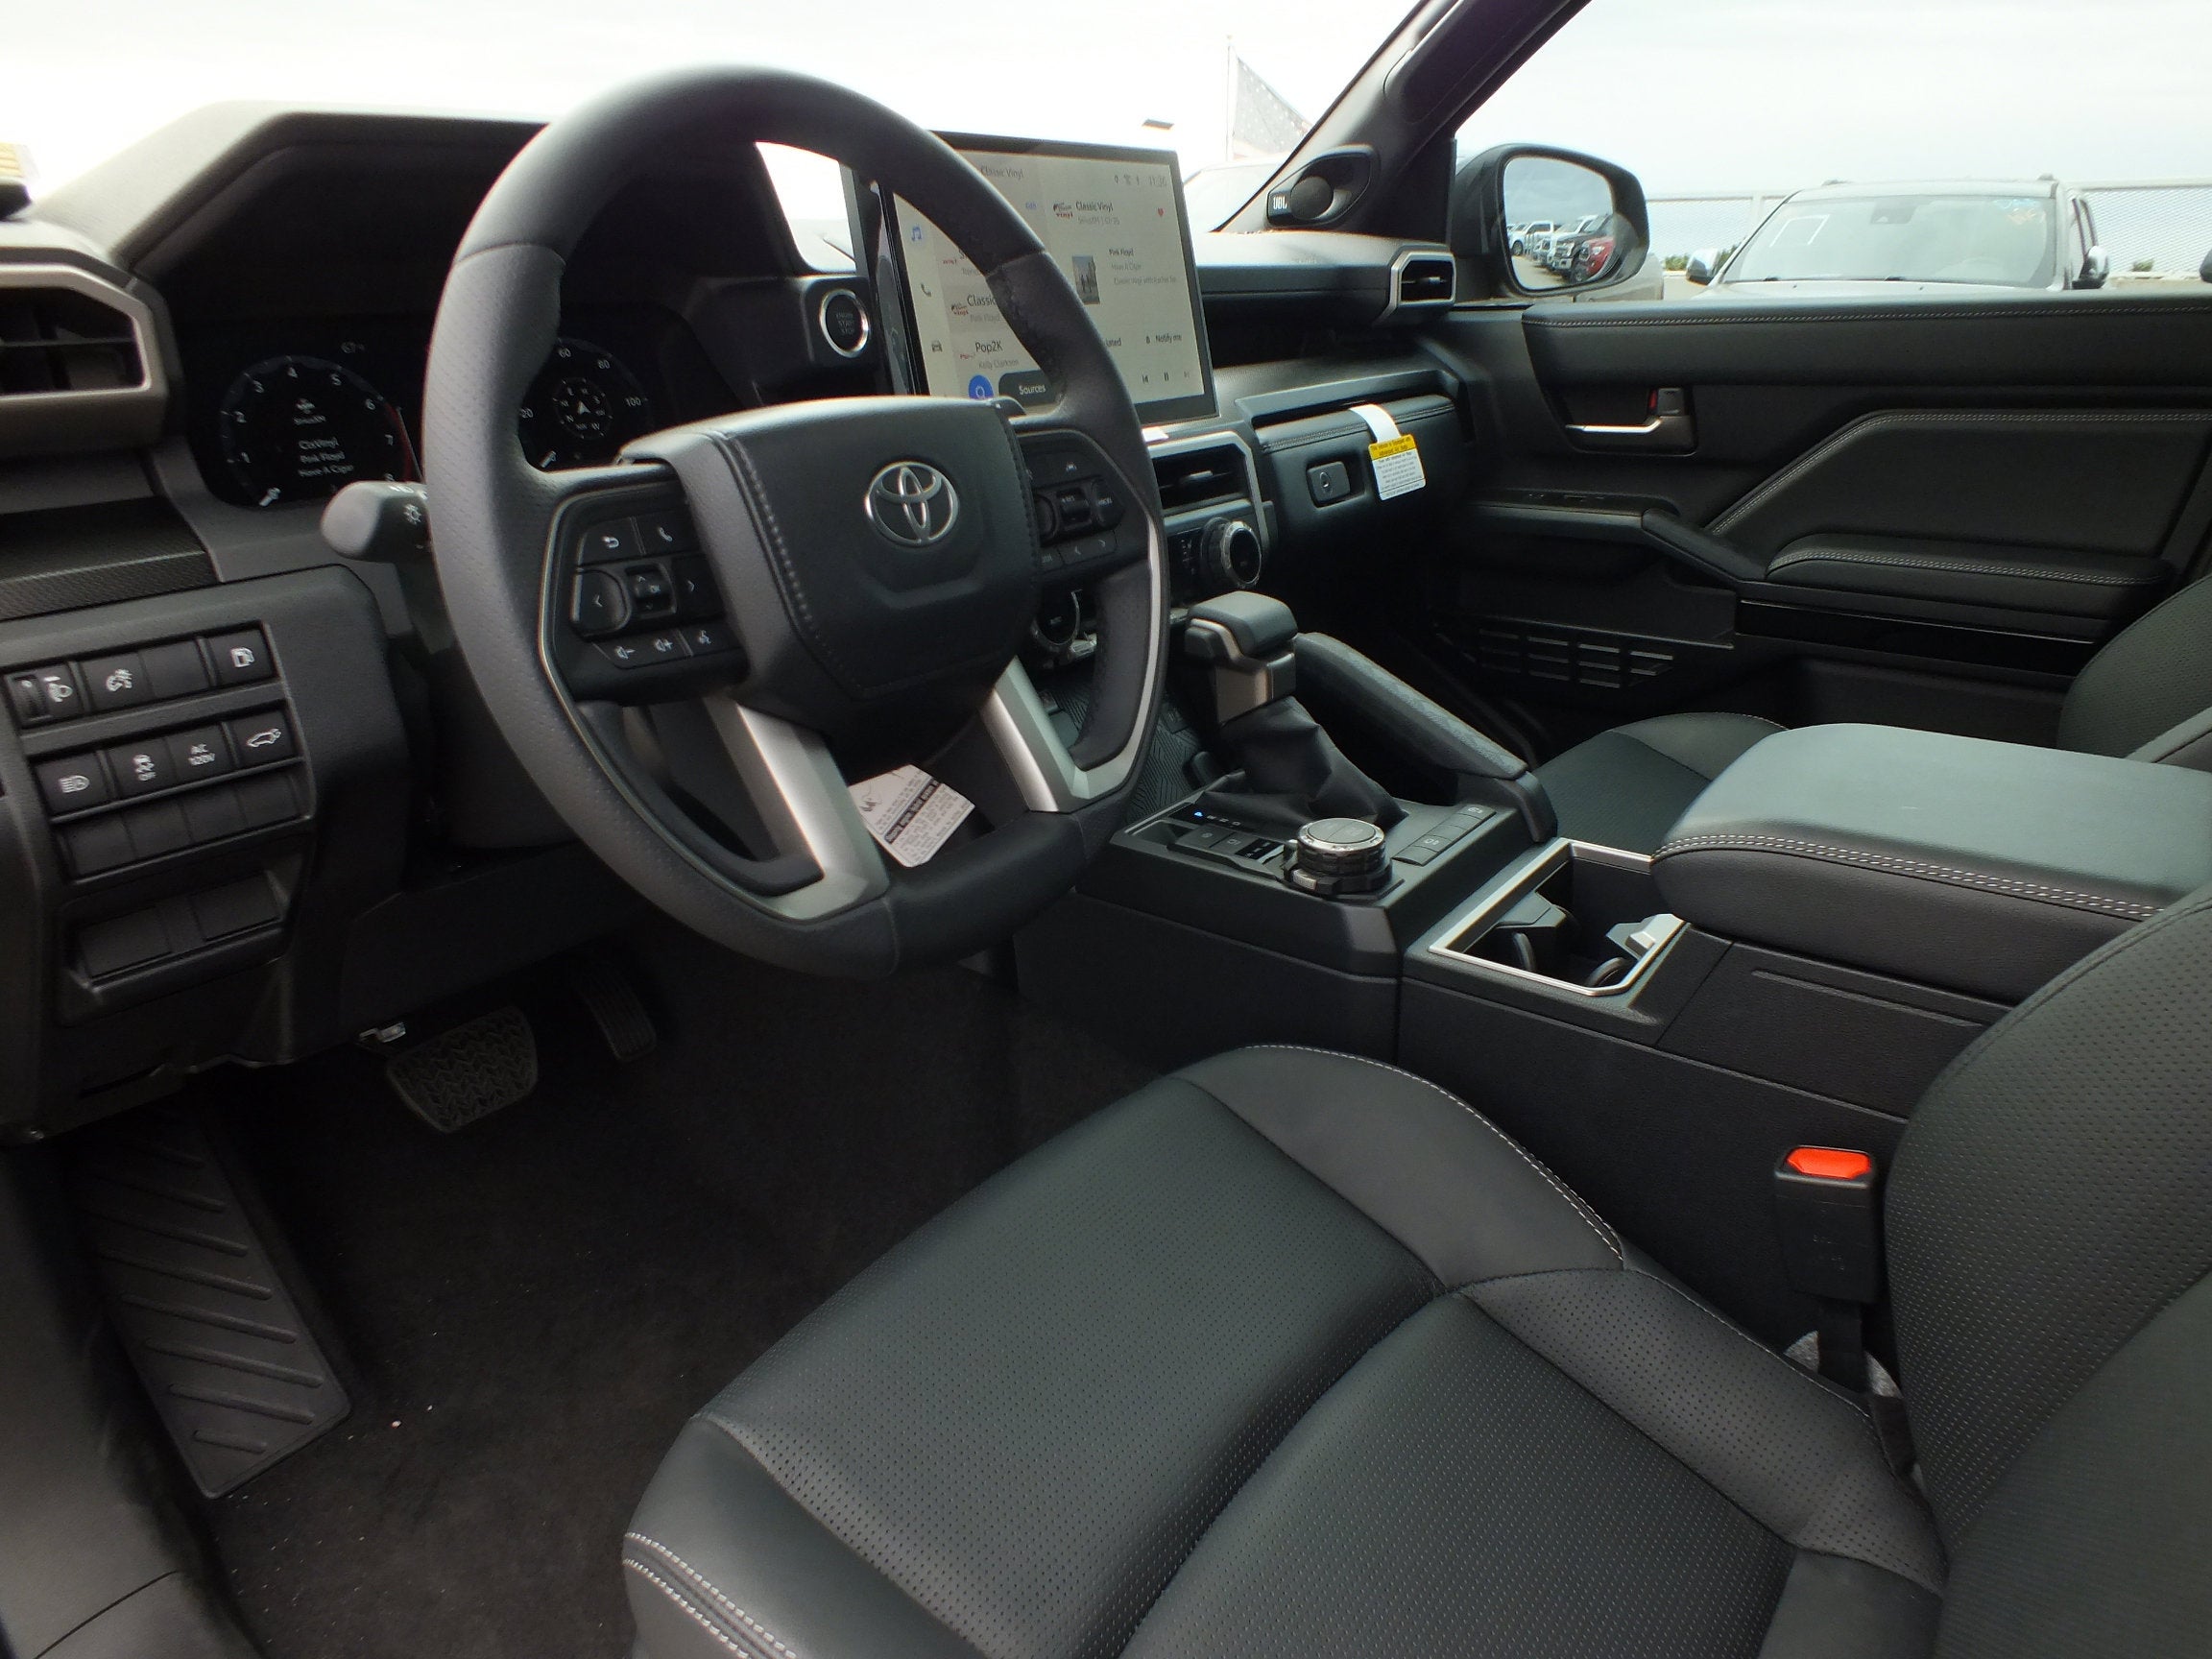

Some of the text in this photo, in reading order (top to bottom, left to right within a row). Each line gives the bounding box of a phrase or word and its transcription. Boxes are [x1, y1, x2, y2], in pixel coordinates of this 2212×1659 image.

[1075, 201, 1097, 211] Classic
[1097, 202, 1114, 213] Vinyl
[967, 294, 997, 306] Classic
[974, 340, 1003, 355] Pop2K
[597, 359, 611, 370] 80
[1019, 384, 1046, 396] Sources
[365, 397, 375, 410] 6
[624, 397, 642, 408] 100
